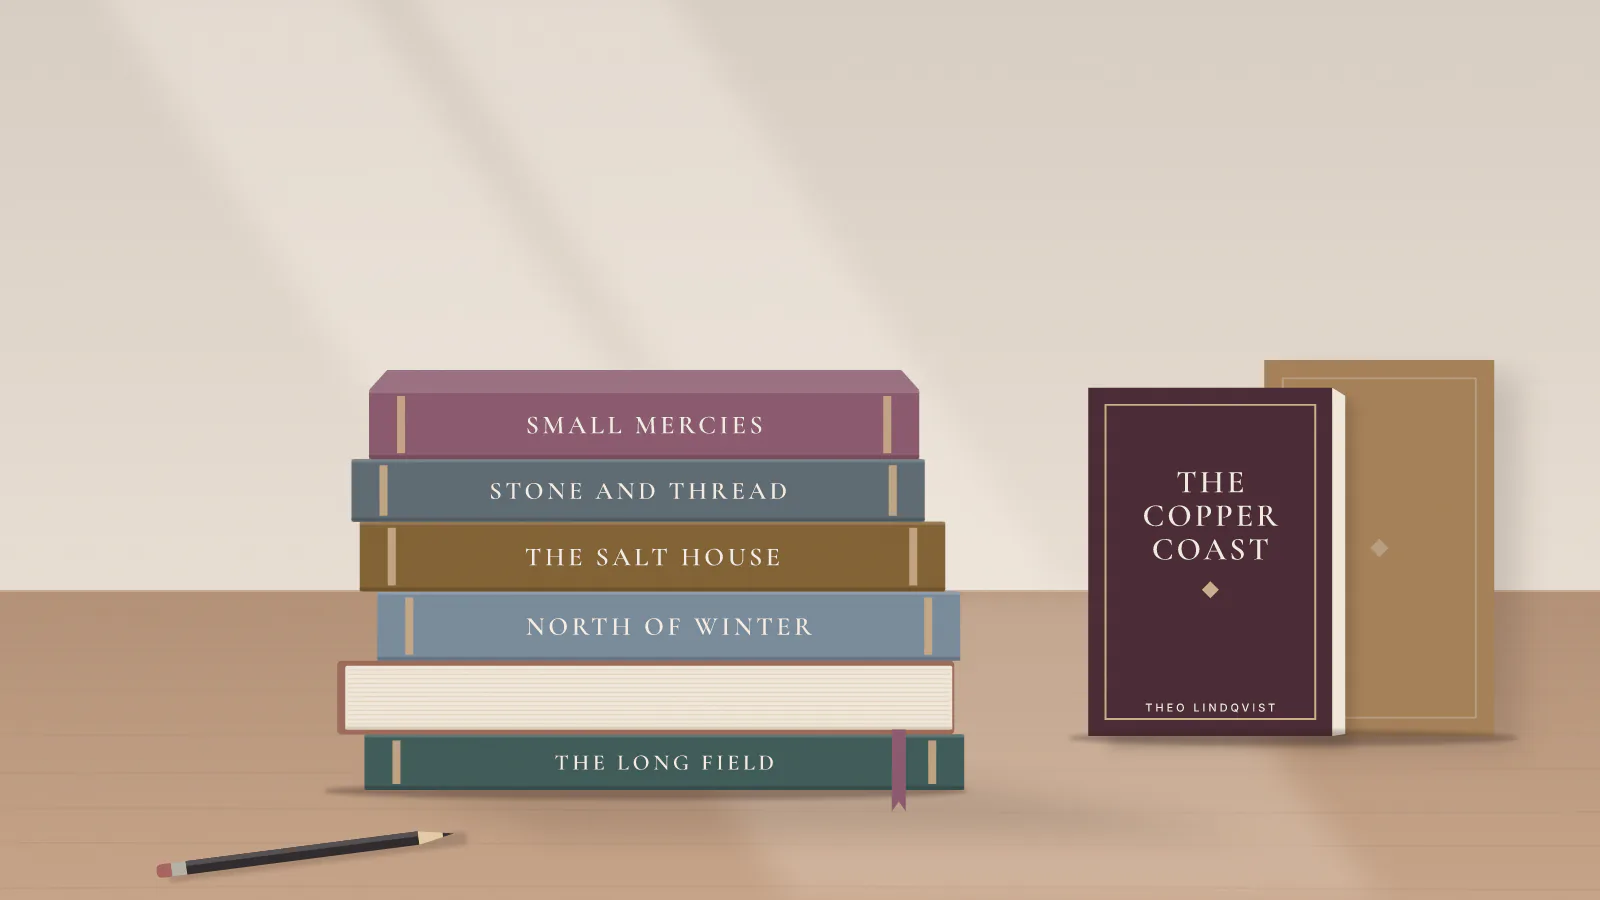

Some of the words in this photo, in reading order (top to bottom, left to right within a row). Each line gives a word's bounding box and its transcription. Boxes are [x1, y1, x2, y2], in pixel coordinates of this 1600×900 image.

[526, 416, 622, 435] SMALL
[635, 416, 762, 435] MERCIES
[490, 482, 582, 500] STONE
[594, 482, 656, 500] AND
[668, 482, 787, 500] THREAD
[1176, 470, 1244, 494] THE
[1143, 504, 1279, 528] COPPER
[525, 547, 583, 567] THE
[596, 547, 668, 567] SALT
[681, 547, 780, 567] HOUSE
[1152, 537, 1269, 561] COAST
[526, 617, 631, 636] NORTH
[644, 617, 681, 636] OF
[693, 617, 813, 636] WINTER
[1144, 702, 1185, 713] THEO
[1193, 702, 1276, 714] LINDQVIST
[554, 754, 605, 771] THE
[617, 754, 689, 771] LONG
[701, 754, 774, 771] FIELD
